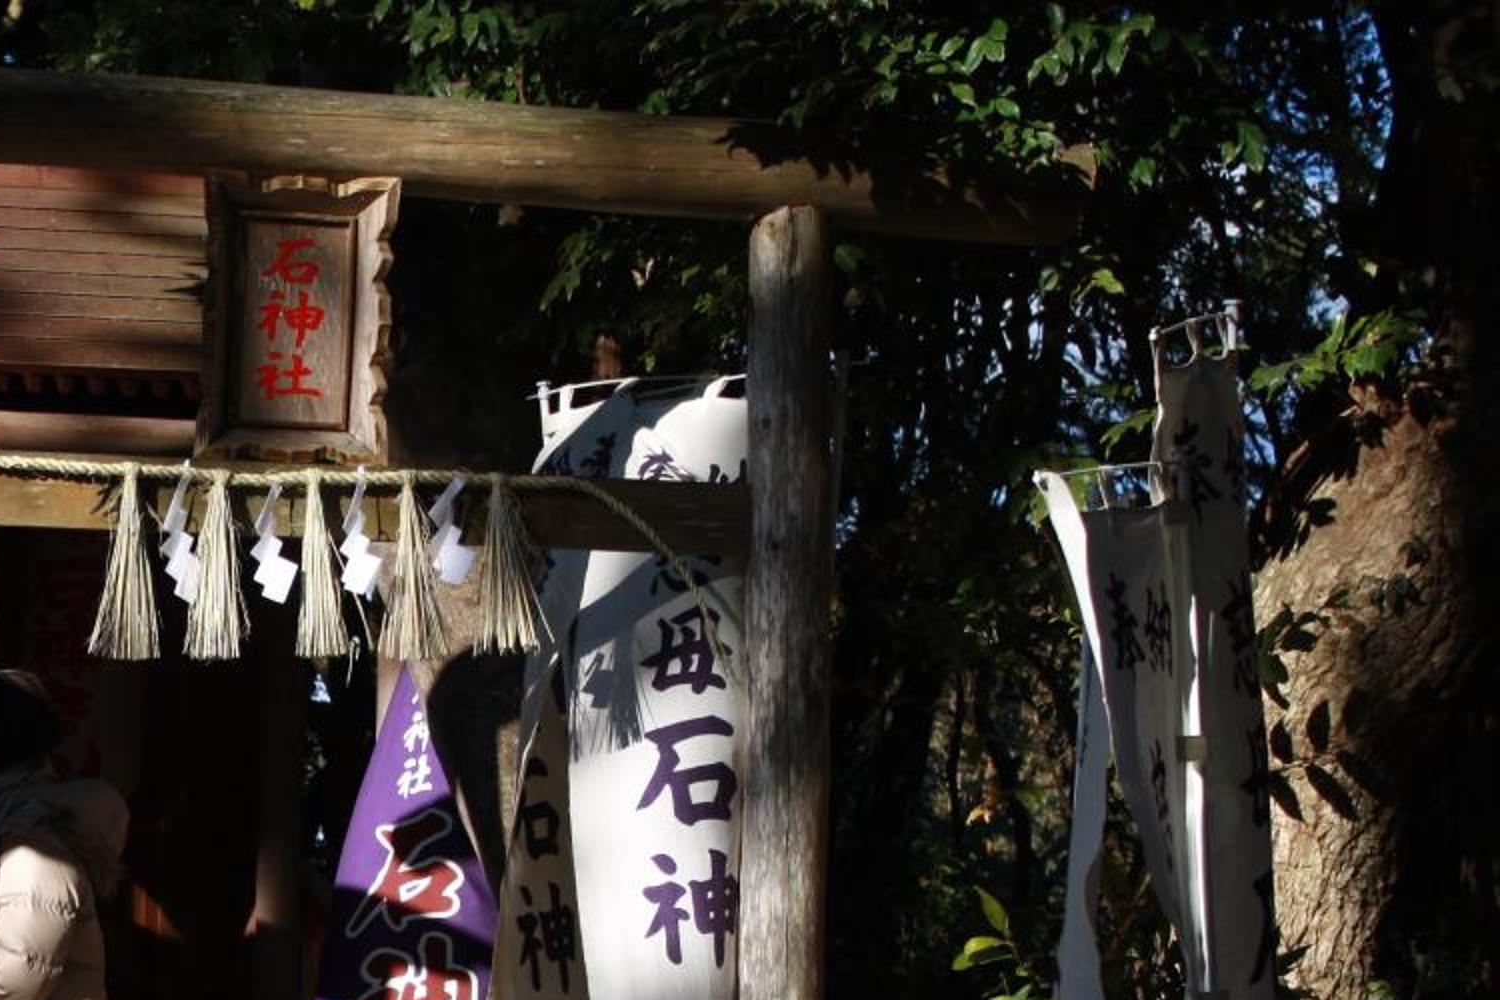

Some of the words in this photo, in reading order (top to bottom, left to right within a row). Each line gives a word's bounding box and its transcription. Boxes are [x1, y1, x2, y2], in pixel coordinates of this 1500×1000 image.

[257, 237, 324, 402] 石神社
[396, 692, 434, 799] 神社
